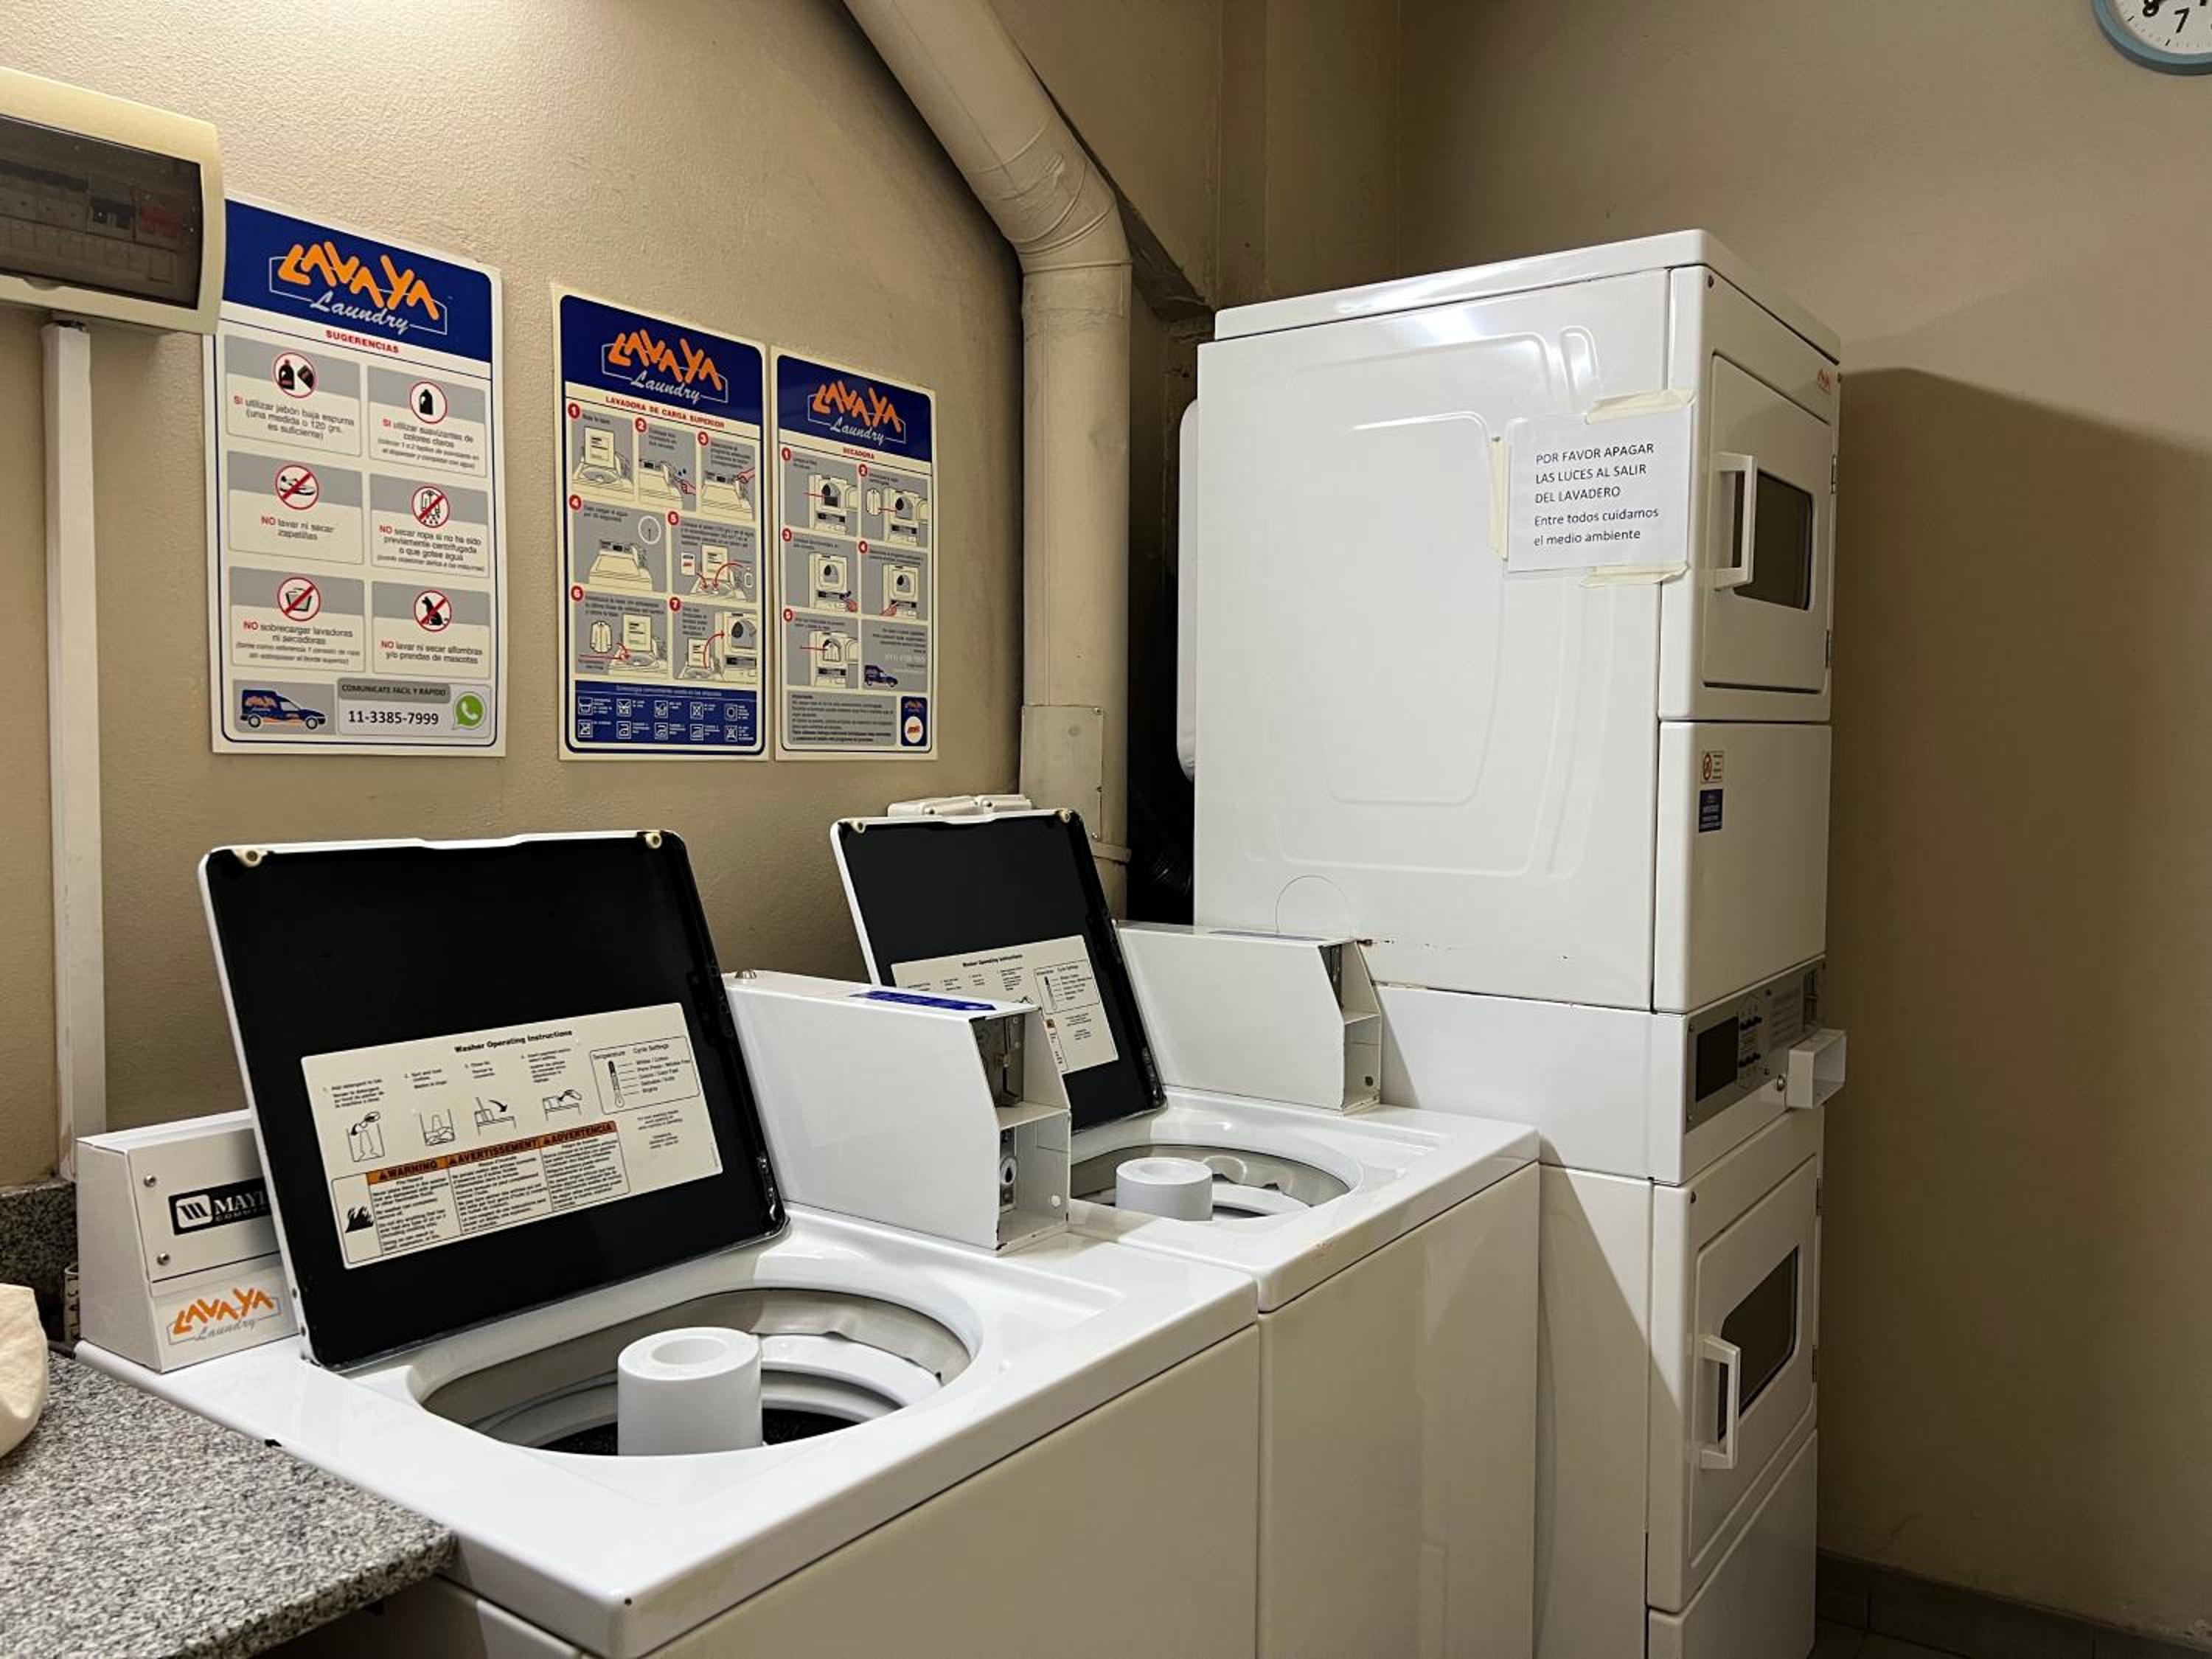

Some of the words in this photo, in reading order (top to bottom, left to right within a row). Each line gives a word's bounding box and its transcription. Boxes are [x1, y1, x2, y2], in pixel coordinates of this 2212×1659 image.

[2174, 7, 2190, 34] 7
[278, 241, 440, 320] LAVAYA
[310, 291, 409, 335] Laundry
[325, 330, 399, 353] SUGERENCIAS
[608, 329, 723, 391] LAVAYA
[630, 369, 700, 404] Laundry
[246, 399, 274, 410] utilizar
[276, 405, 301, 417] jabón
[302, 408, 320, 422] baja
[322, 412, 355, 426] espuma
[606, 396, 647, 414] LAVADORA
[650, 406, 660, 415] DE
[661, 408, 687, 421] CARGA
[689, 414, 724, 428] SUPERIOR
[813, 380, 902, 433] LAVAYA
[268, 413, 300, 426] medida
[311, 421, 326, 431] 120
[268, 423, 279, 431] es
[281, 425, 324, 440] suficiente)
[394, 422, 417, 432] utilizar
[465, 434, 474, 442] de
[830, 416, 886, 446] Laundry
[403, 432, 431, 444] colores
[433, 437, 454, 448] claros
[843, 447, 874, 460] SECADORA
[1536, 453, 1559, 465] POR
[1562, 448, 1601, 462] FAVOR
[1604, 443, 1654, 457] APAGAR
[1536, 473, 1554, 484] LAS
[1558, 468, 1593, 481] LUCES
[1596, 467, 1610, 478] AL
[1614, 464, 1646, 477] SALIR
[1536, 493, 1555, 503] DEL
[1558, 486, 1621, 502] LAVADERO
[261, 516, 276, 526] NO
[278, 519, 299, 529] lavar
[300, 522, 309, 530] ni
[310, 524, 334, 533] secar
[1534, 515, 1564, 526] Entre
[1567, 512, 1599, 524] todos
[1602, 508, 1658, 521] cuidamos
[278, 529, 318, 540] zapatillas
[379, 525, 393, 535] NO
[394, 528, 415, 538] secar
[417, 532, 434, 542] ropa
[436, 534, 442, 542] si
[444, 535, 453, 543] no
[455, 537, 465, 545] ha
[466, 539, 481, 548] sido
[1534, 535, 1543, 546] el
[1546, 533, 1582, 546] medio
[1585, 530, 1641, 541] ambiente
[384, 537, 431, 549] previamente
[432, 542, 477, 555] centrifugada
[406, 549, 421, 559] que
[422, 552, 442, 562] gotee
[445, 553, 464, 563] agua
[244, 622, 259, 630] NO
[260, 624, 310, 636] sobrecargar
[313, 628, 353, 639] lavadoras
[282, 636, 327, 646] secadoras
[381, 641, 394, 650] NO
[396, 642, 415, 652] lavar
[425, 645, 446, 654] secar
[448, 646, 483, 657] alfombras
[386, 652, 399, 661] y/o
[400, 653, 431, 662] prendas
[432, 654, 442, 662] de
[444, 655, 479, 665] mascotas
[342, 684, 392, 695] COMUNICATE
[348, 710, 439, 725] 11-3385-7999
[454, 1043, 484, 1053] Washer
[487, 1037, 526, 1048] Operating
[528, 1030, 572, 1042] Instructions
[551, 1124, 612, 1145] ADVERTENCIA
[458, 1139, 539, 1163] AVERTISSEMENT
[387, 1160, 437, 1178] WARNING
[173, 1288, 274, 1335] LAVAYA
[195, 1319, 255, 1341] Laundry
